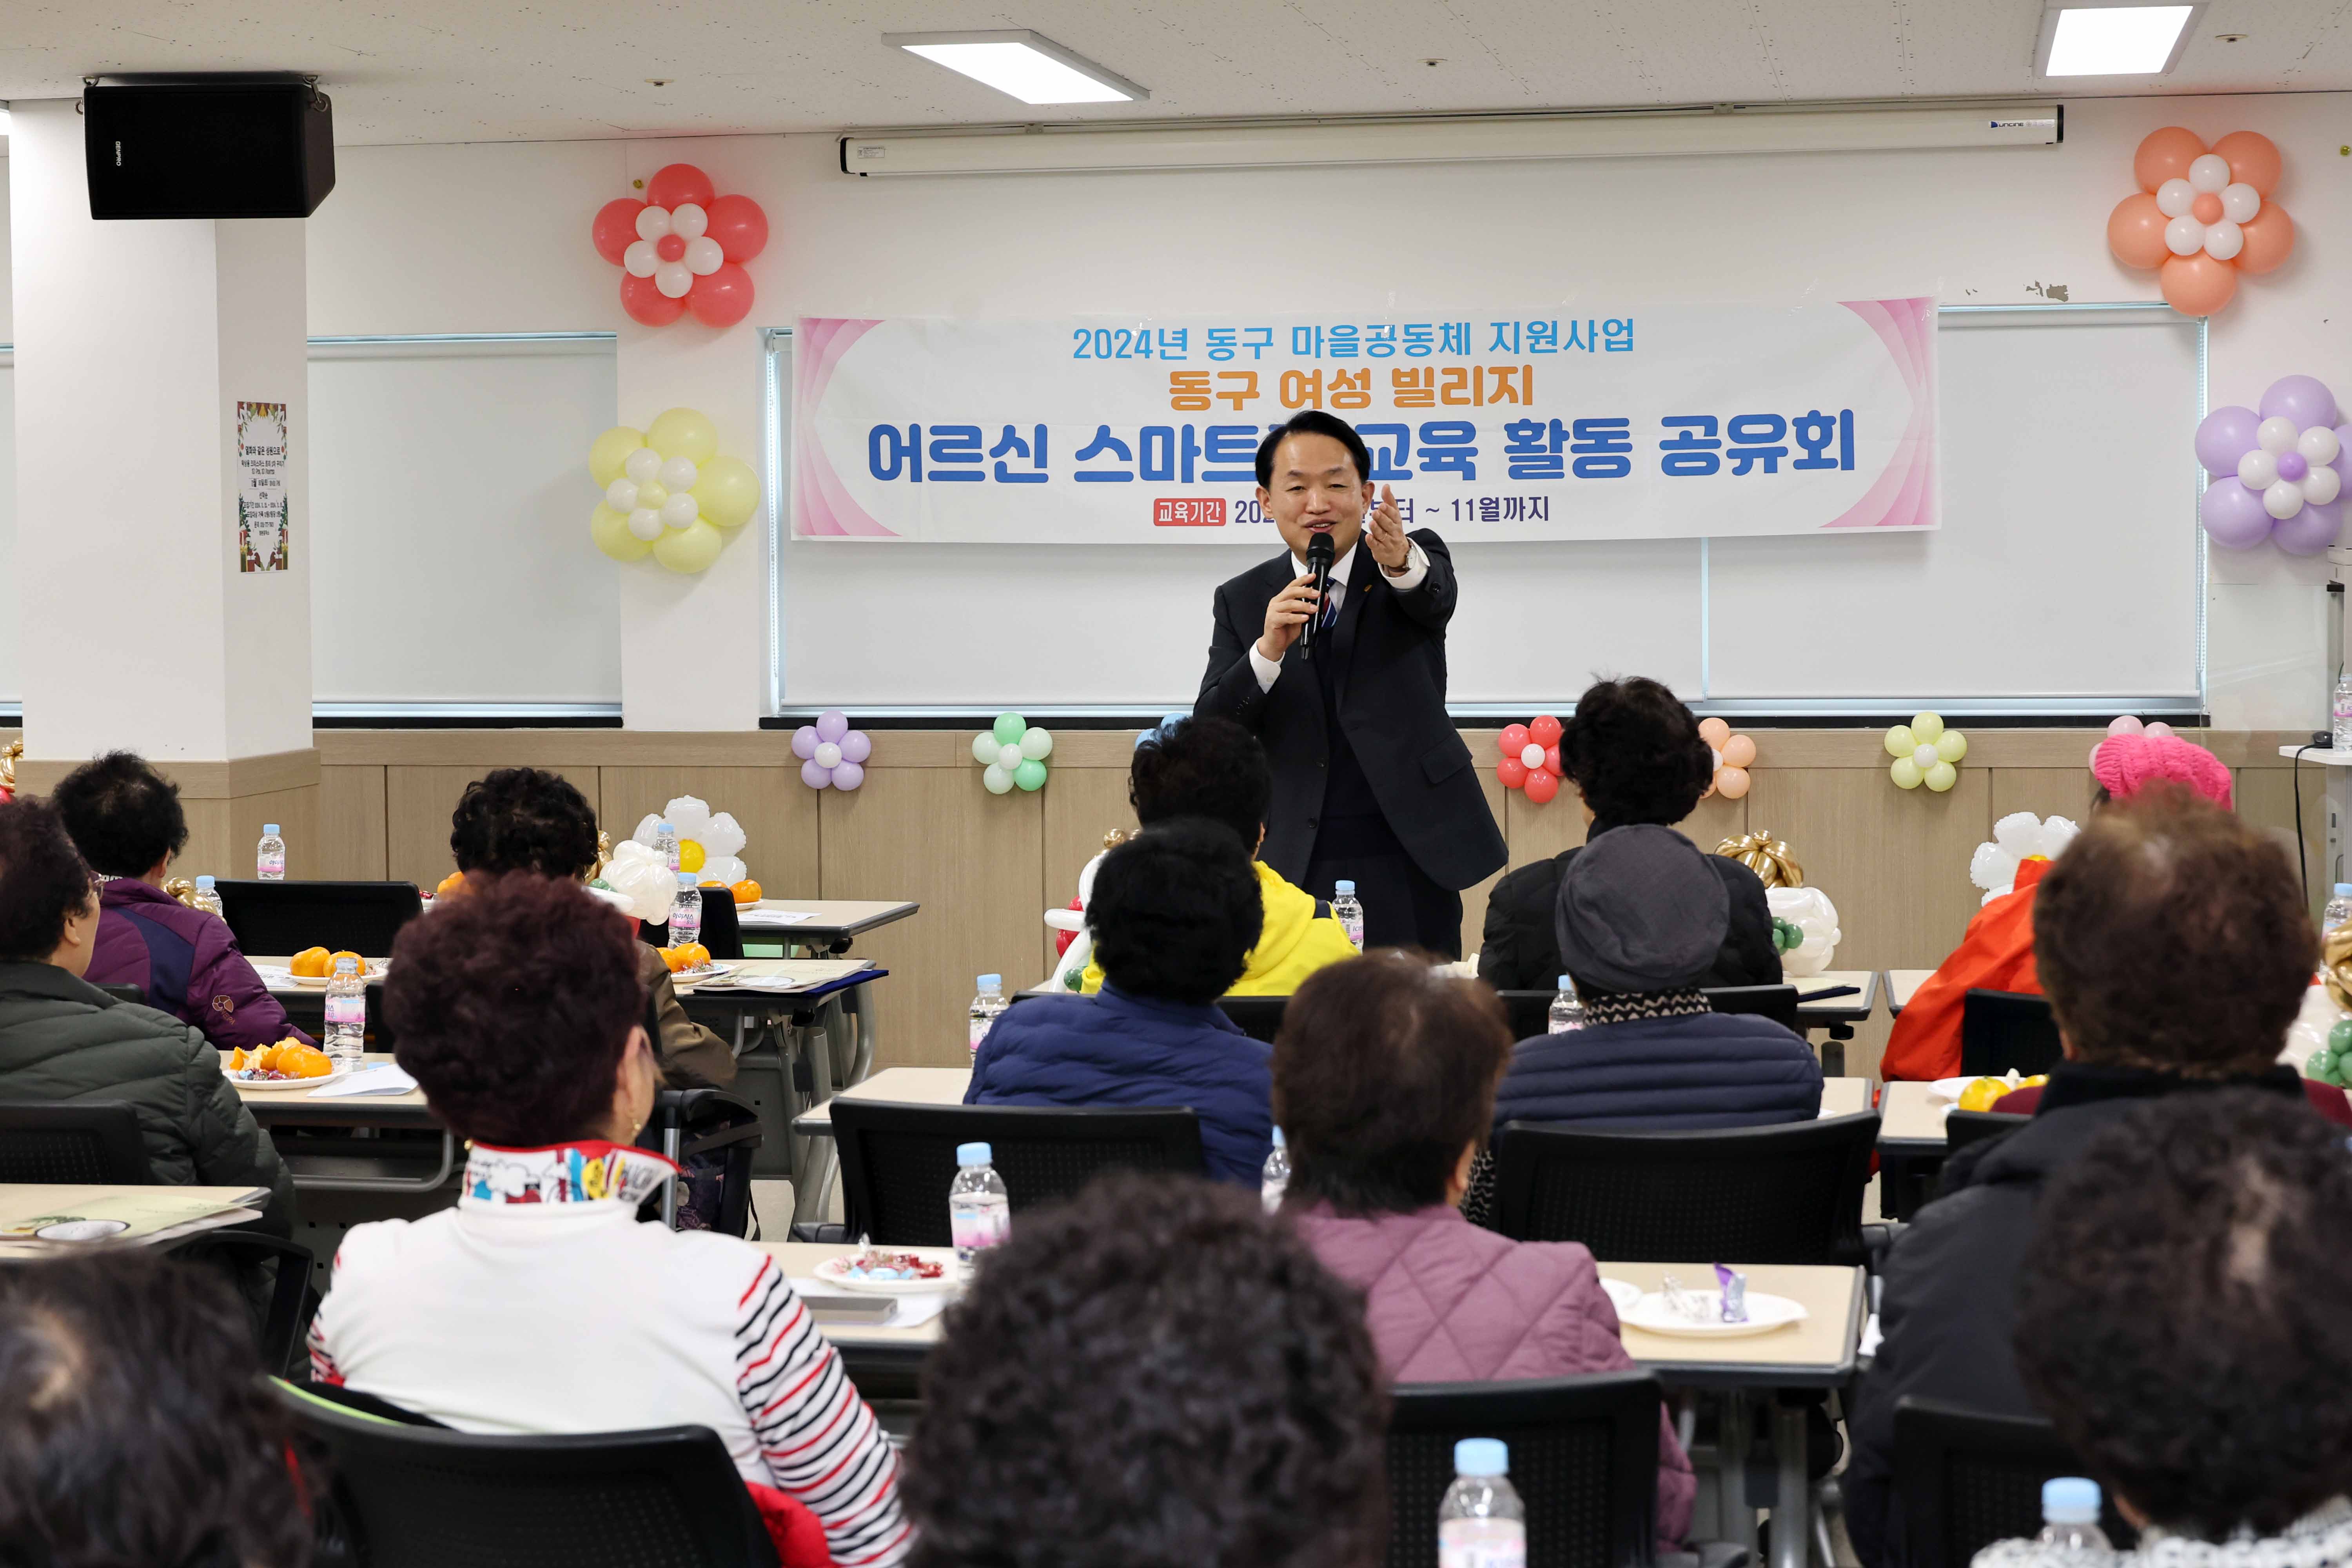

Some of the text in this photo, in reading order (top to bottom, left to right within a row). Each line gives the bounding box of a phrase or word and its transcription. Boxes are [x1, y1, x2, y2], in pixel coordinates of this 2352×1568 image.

[1074, 319, 1633, 361] 2024년 동구 마을공동체 지원사업
[1171, 365, 1532, 410] 동구 여성 빌리지
[869, 410, 1855, 483] 어르신 스마트 교육 활동 공유회
[1158, 501, 1221, 523] 교육기간
[1452, 496, 1548, 522] 11월까지
